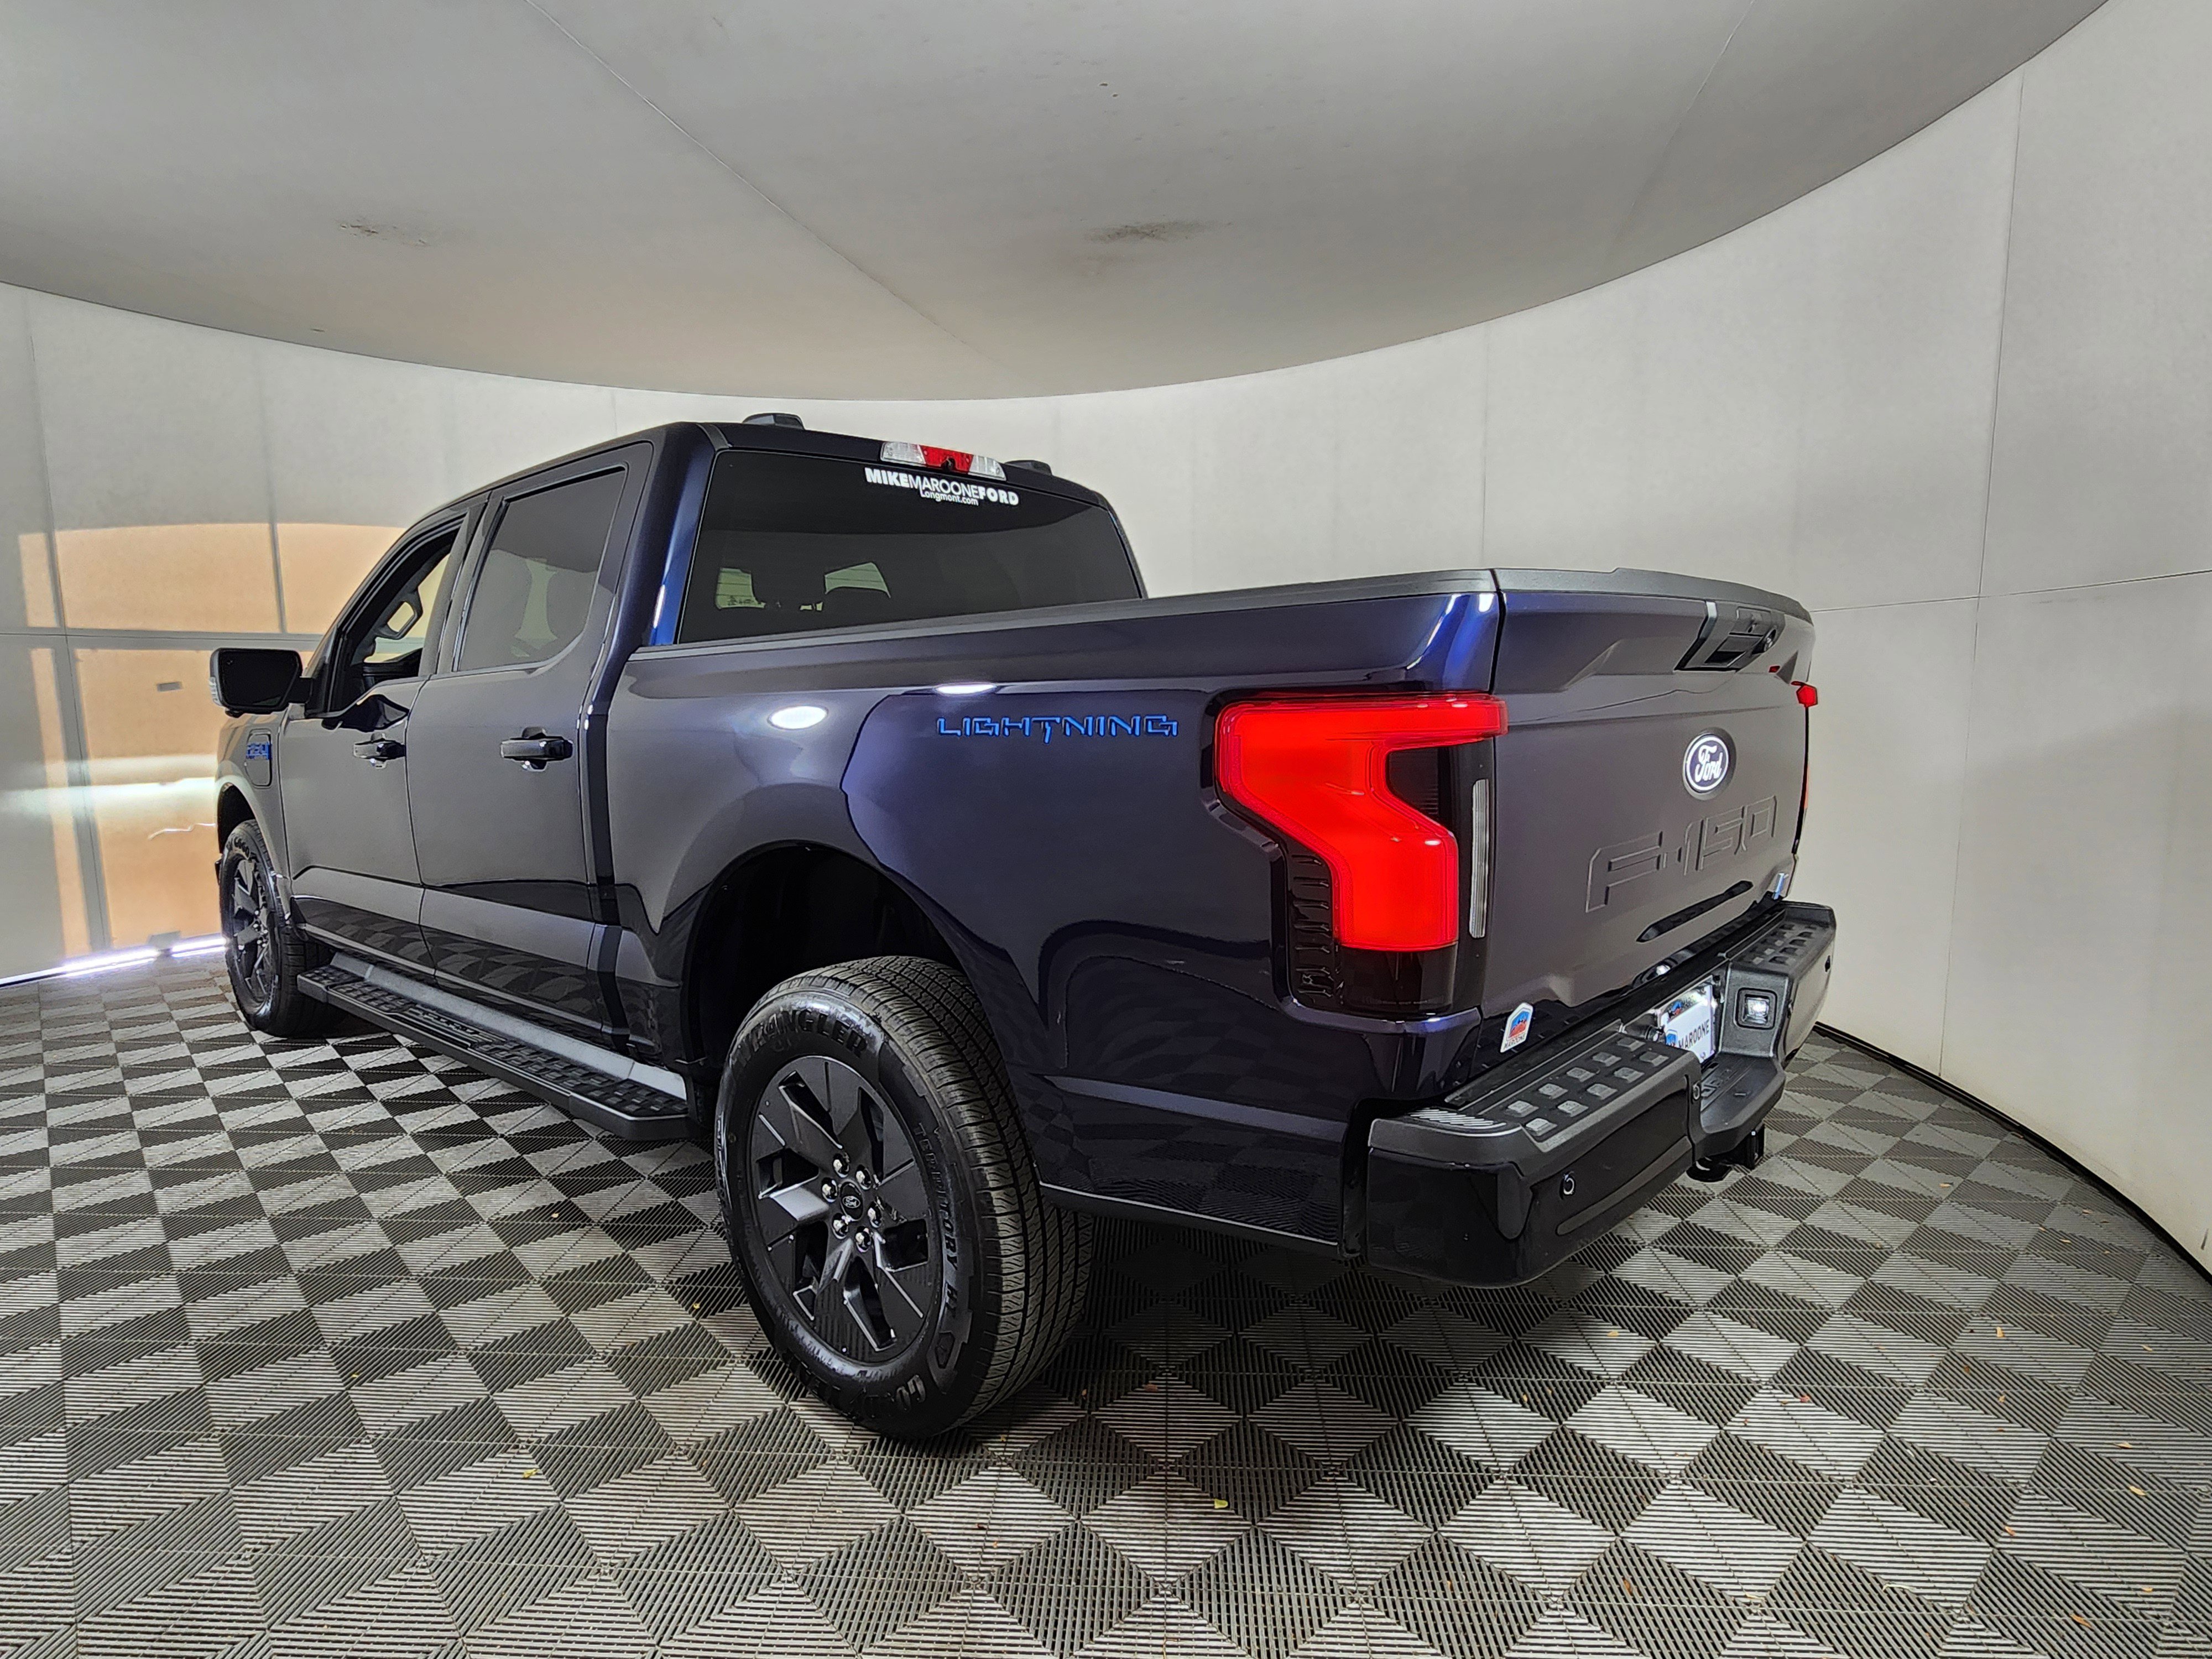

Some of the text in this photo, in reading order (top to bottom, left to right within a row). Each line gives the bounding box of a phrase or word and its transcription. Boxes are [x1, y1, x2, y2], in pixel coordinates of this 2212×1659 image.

[919, 487, 979, 506] Longmont.com
[937, 714, 1178, 744] LIGHTNING
[1694, 744, 1724, 782] Ford
[1585, 795, 1777, 913] F-150
[731, 1008, 868, 1068] WRANGLER
[1678, 1019, 1710, 1048] MAROONE
